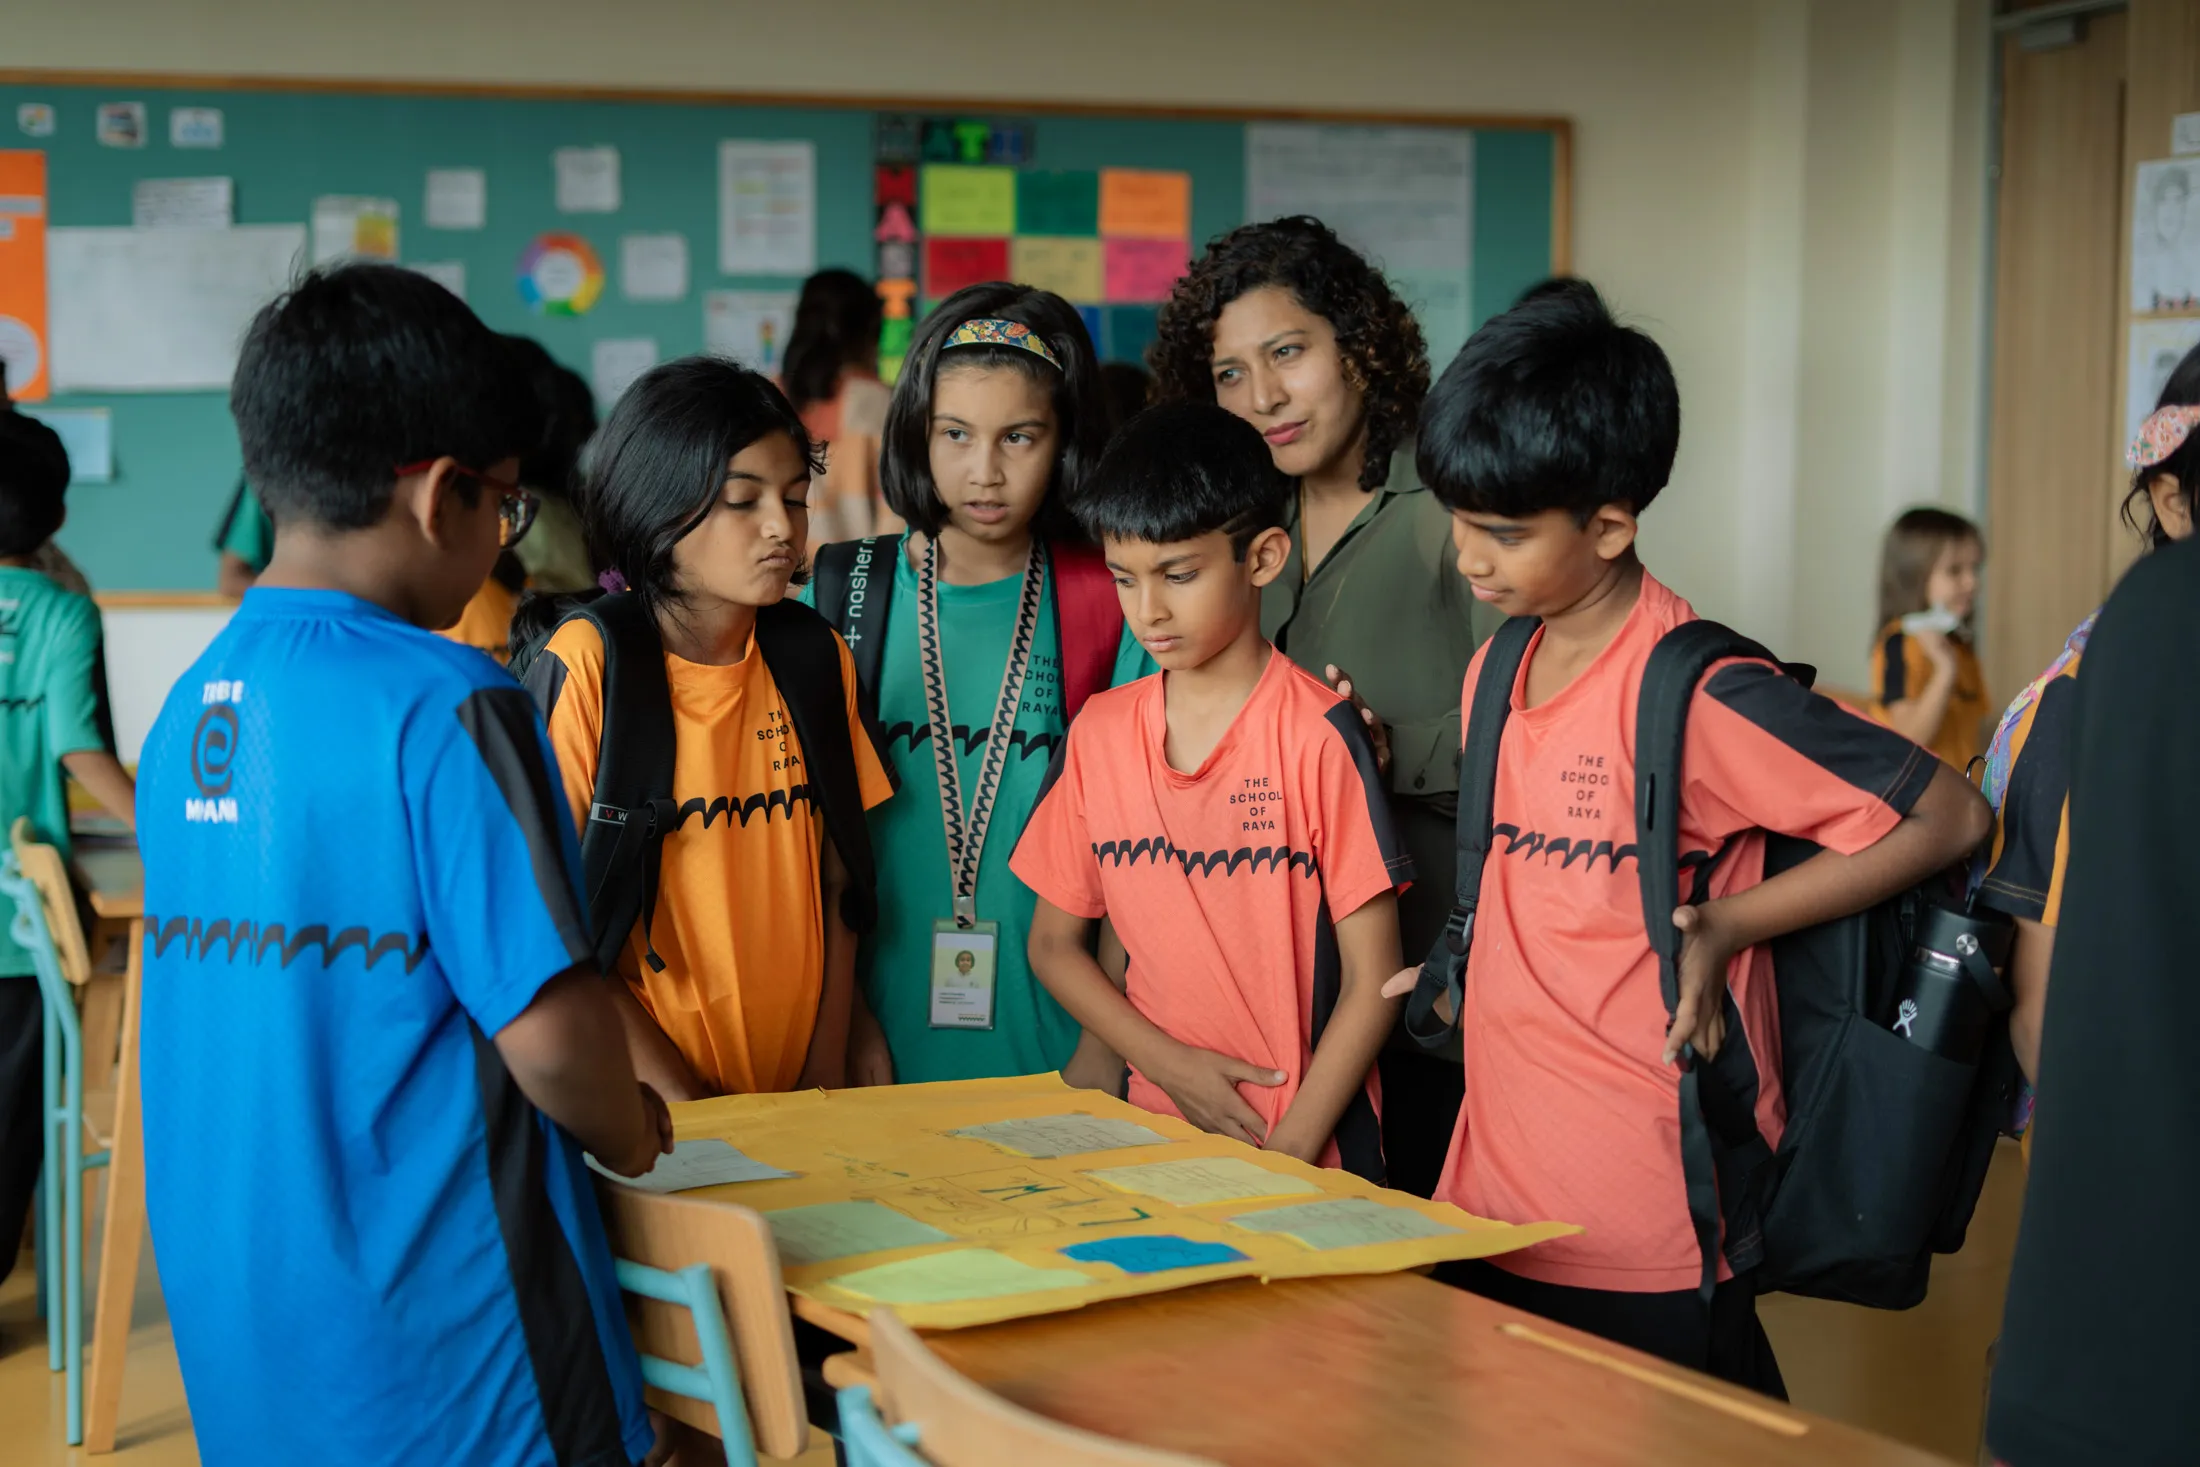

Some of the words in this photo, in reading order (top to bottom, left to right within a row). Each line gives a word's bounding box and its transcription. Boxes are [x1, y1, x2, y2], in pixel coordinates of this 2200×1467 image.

[848, 547, 873, 617] nasher
[1035, 687, 1053, 698] OF
[1022, 702, 1059, 716] RAYA
[1577, 755, 1604, 768] THE
[1244, 777, 1269, 788] THE
[1229, 791, 1283, 804] SCHOOL
[1576, 789, 1595, 801] OF
[1250, 807, 1266, 816] OF
[1568, 806, 1601, 819] RAYA
[1242, 820, 1275, 831] RAYA
